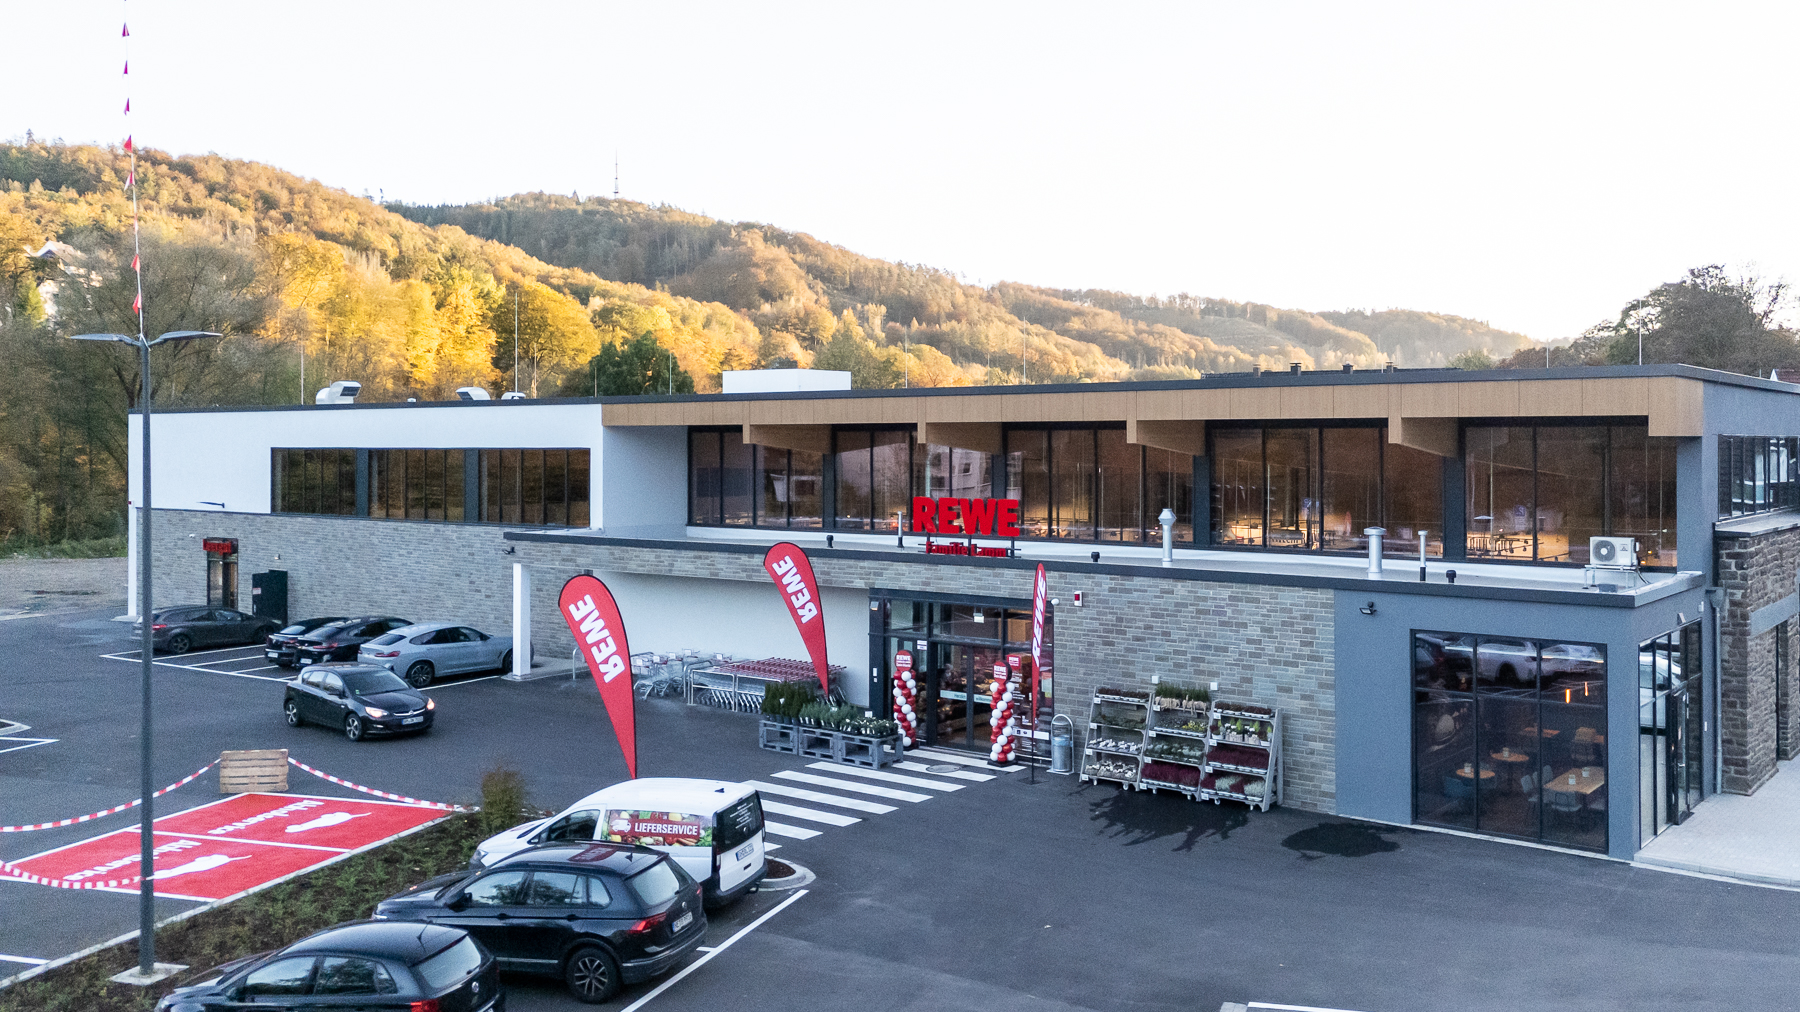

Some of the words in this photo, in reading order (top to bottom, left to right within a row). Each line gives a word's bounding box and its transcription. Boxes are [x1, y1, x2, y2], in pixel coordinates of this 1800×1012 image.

[912, 496, 1020, 537] REWE
[1032, 570, 1046, 668] REWE
[207, 799, 325, 835] Abholservice
[634, 822, 698, 836] LIEFERSERVICE
